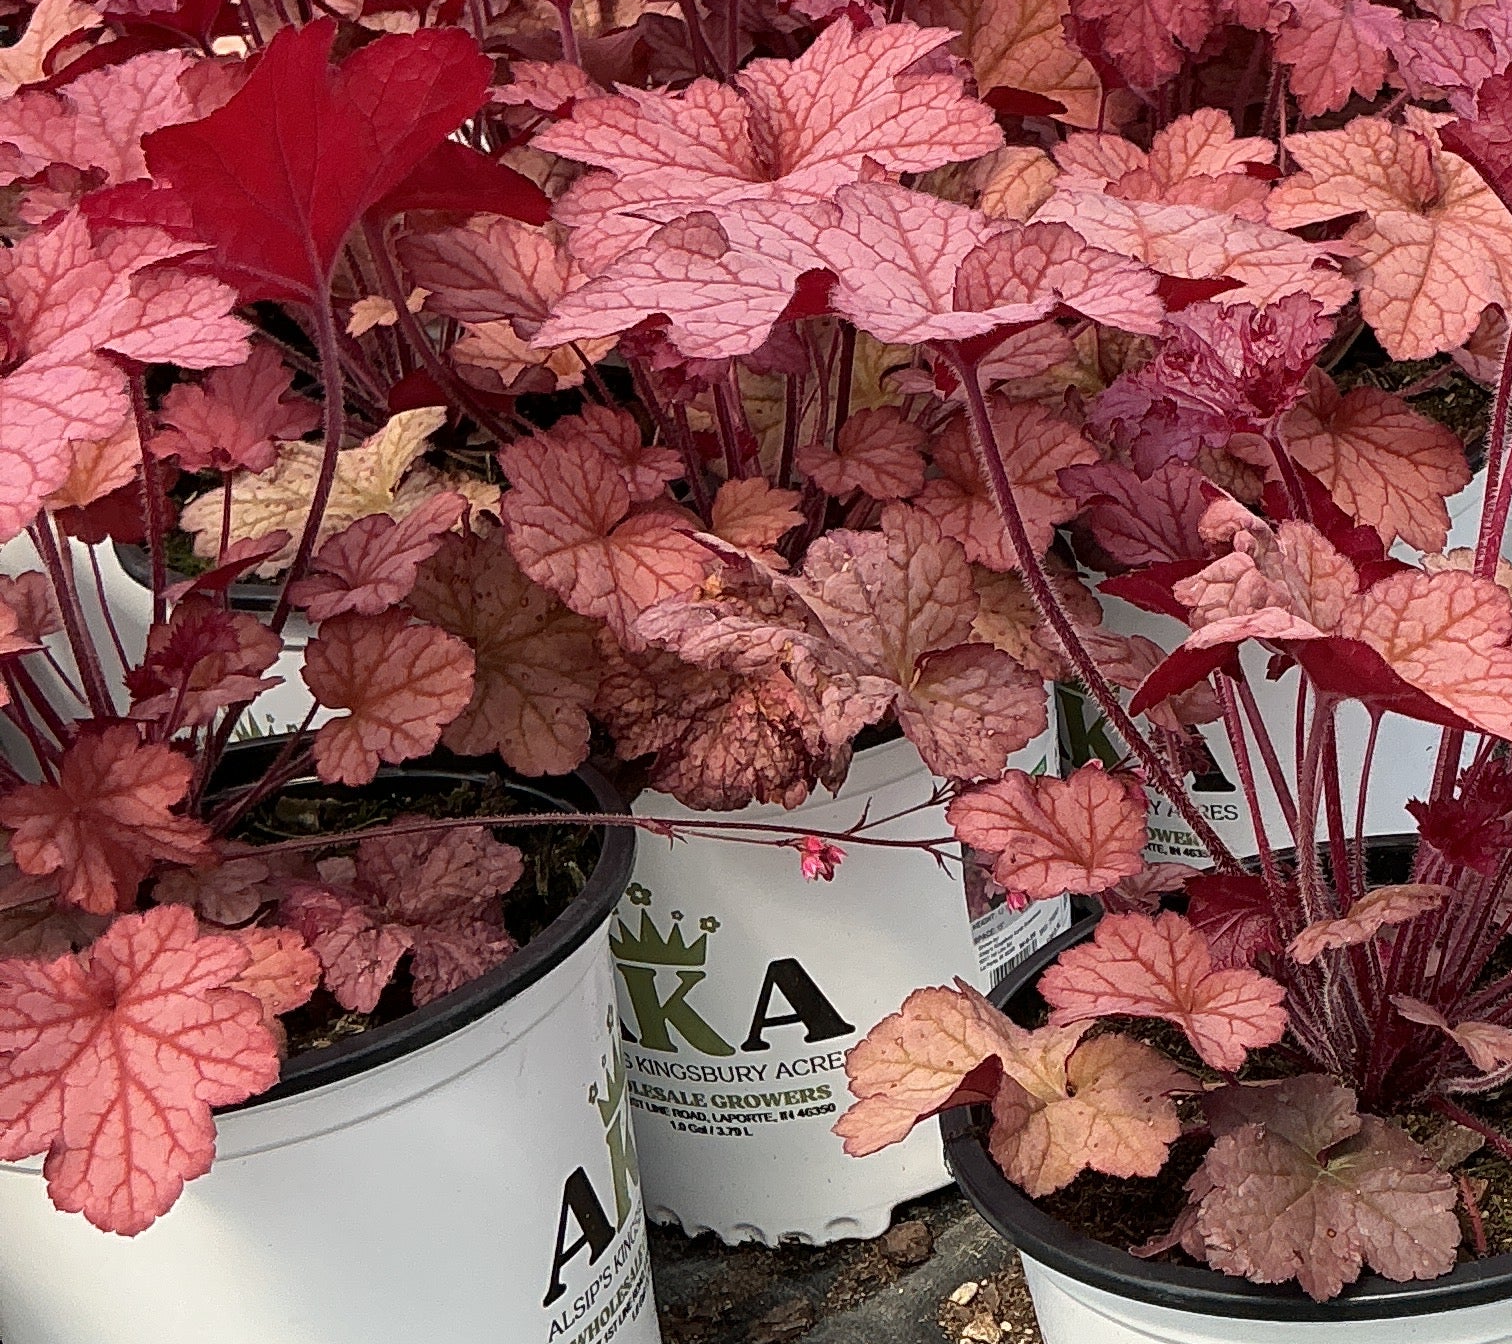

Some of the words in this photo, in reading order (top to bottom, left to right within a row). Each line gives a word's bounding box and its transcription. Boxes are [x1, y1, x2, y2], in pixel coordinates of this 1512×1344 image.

[617, 958, 856, 1057] KA
[638, 1057, 774, 1084] KINGSBURY
[775, 1050, 853, 1080] ACRE
[628, 1080, 708, 1108] LESALE
[710, 1084, 833, 1110] GROWERS
[795, 1102, 837, 1118] 46350
[548, 1265, 613, 1343] ALSIP'S
